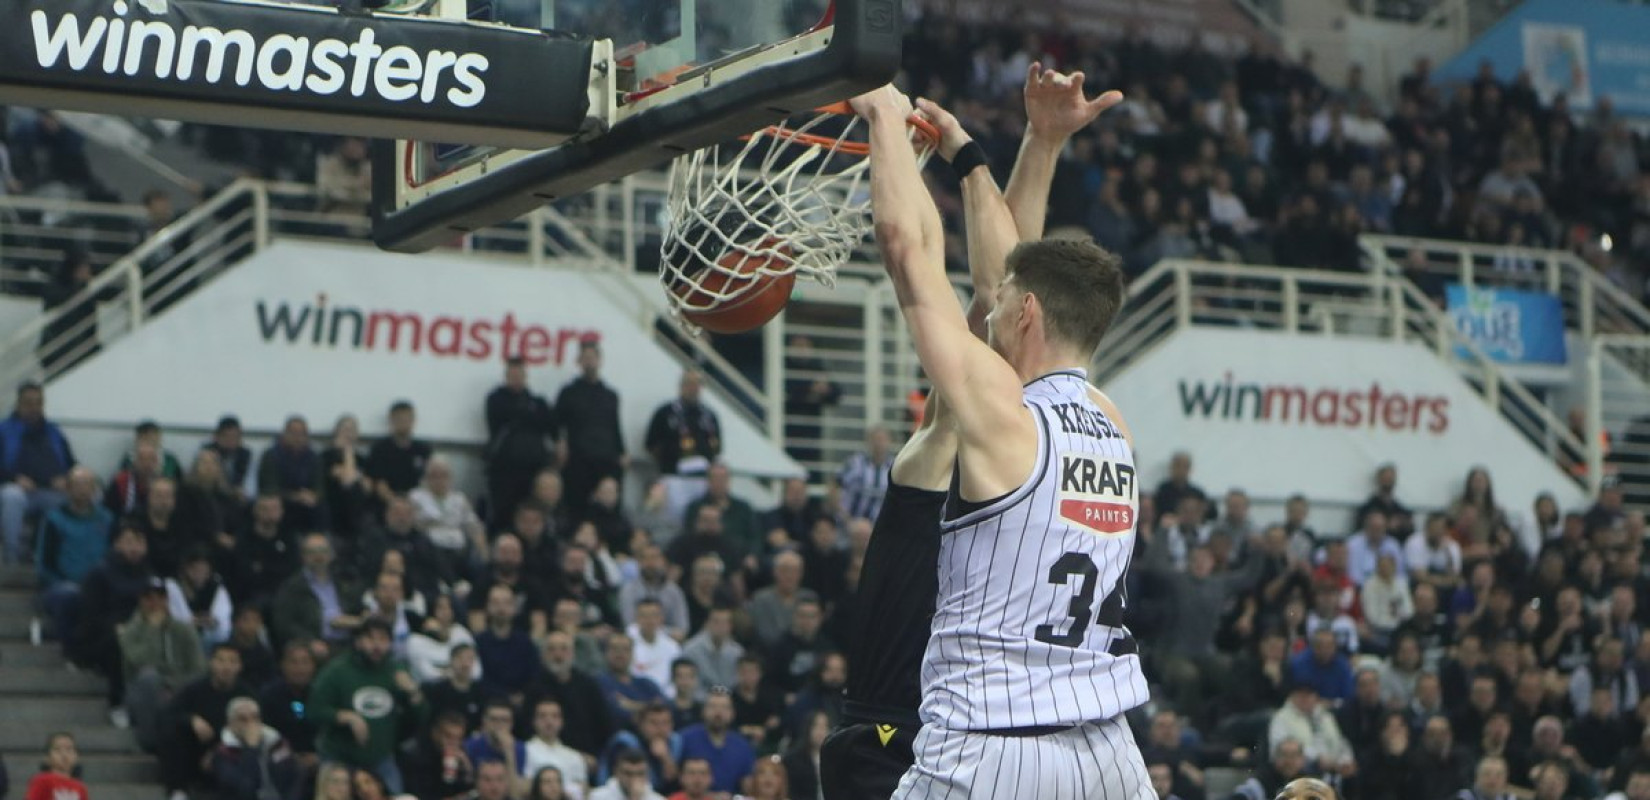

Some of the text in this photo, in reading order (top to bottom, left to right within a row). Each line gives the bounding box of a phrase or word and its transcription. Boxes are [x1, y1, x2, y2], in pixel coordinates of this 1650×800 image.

[31, 0, 489, 107] winmasters
[1178, 370, 1450, 434] winmasters
[1061, 456, 1134, 500] KRAFT
[1085, 508, 1129, 523] PAINTS
